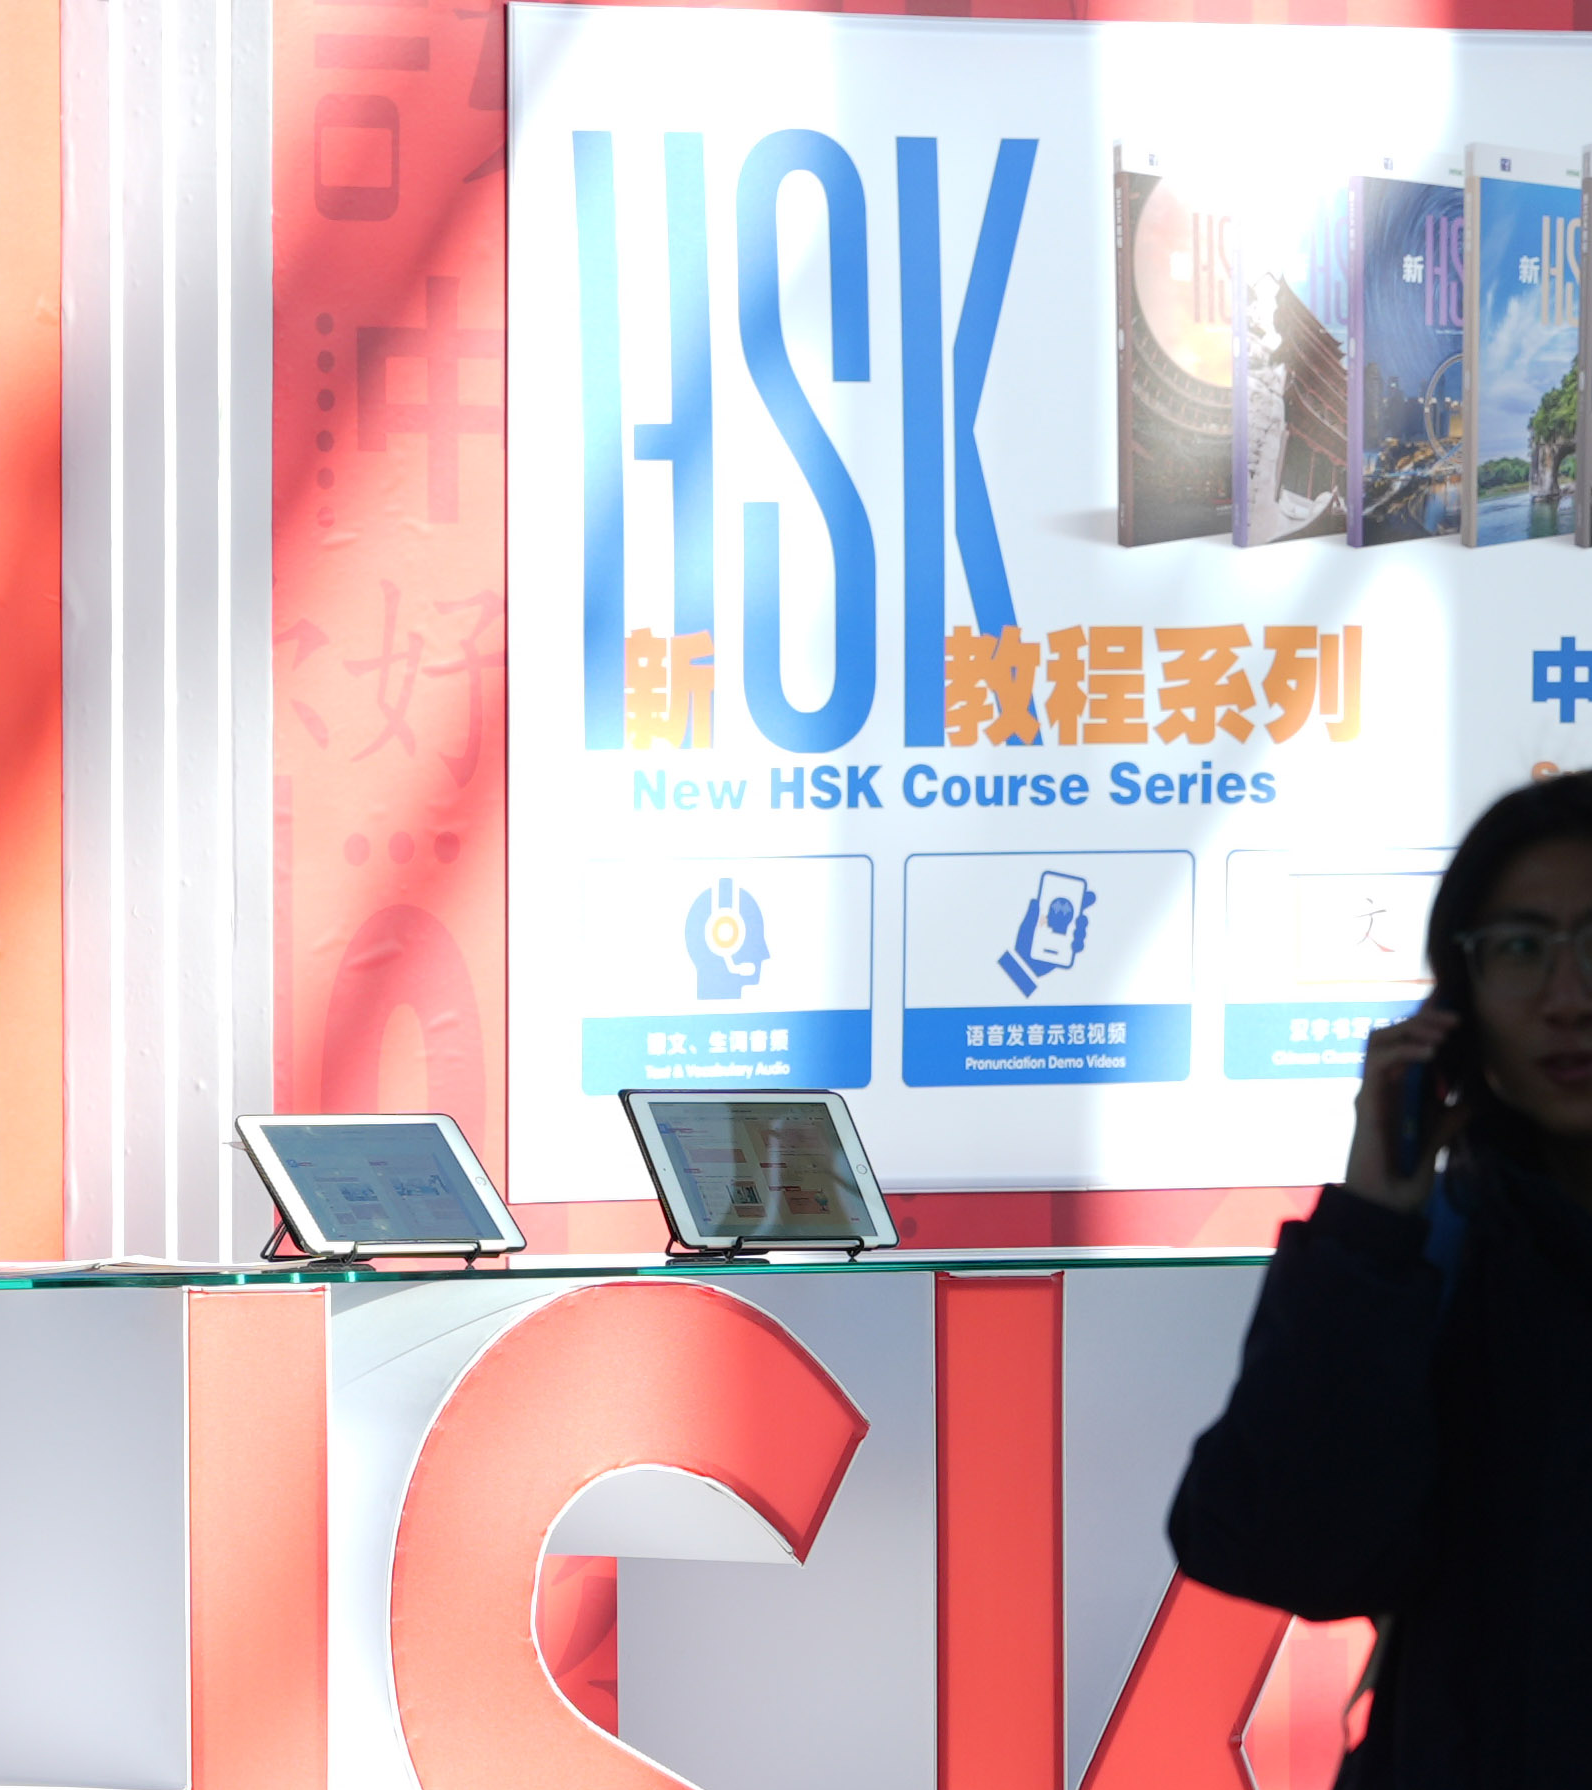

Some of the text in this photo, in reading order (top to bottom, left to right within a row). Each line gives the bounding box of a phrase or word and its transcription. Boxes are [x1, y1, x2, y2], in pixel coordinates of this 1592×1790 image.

[571, 128, 1039, 755] HSK
[944, 624, 1363, 747] 教程系列
[632, 761, 1277, 811] New HSK Course Series
[966, 1022, 1127, 1047] 语音发音示范视频
[965, 1054, 1127, 1071] Pronunciation Demo Videos
